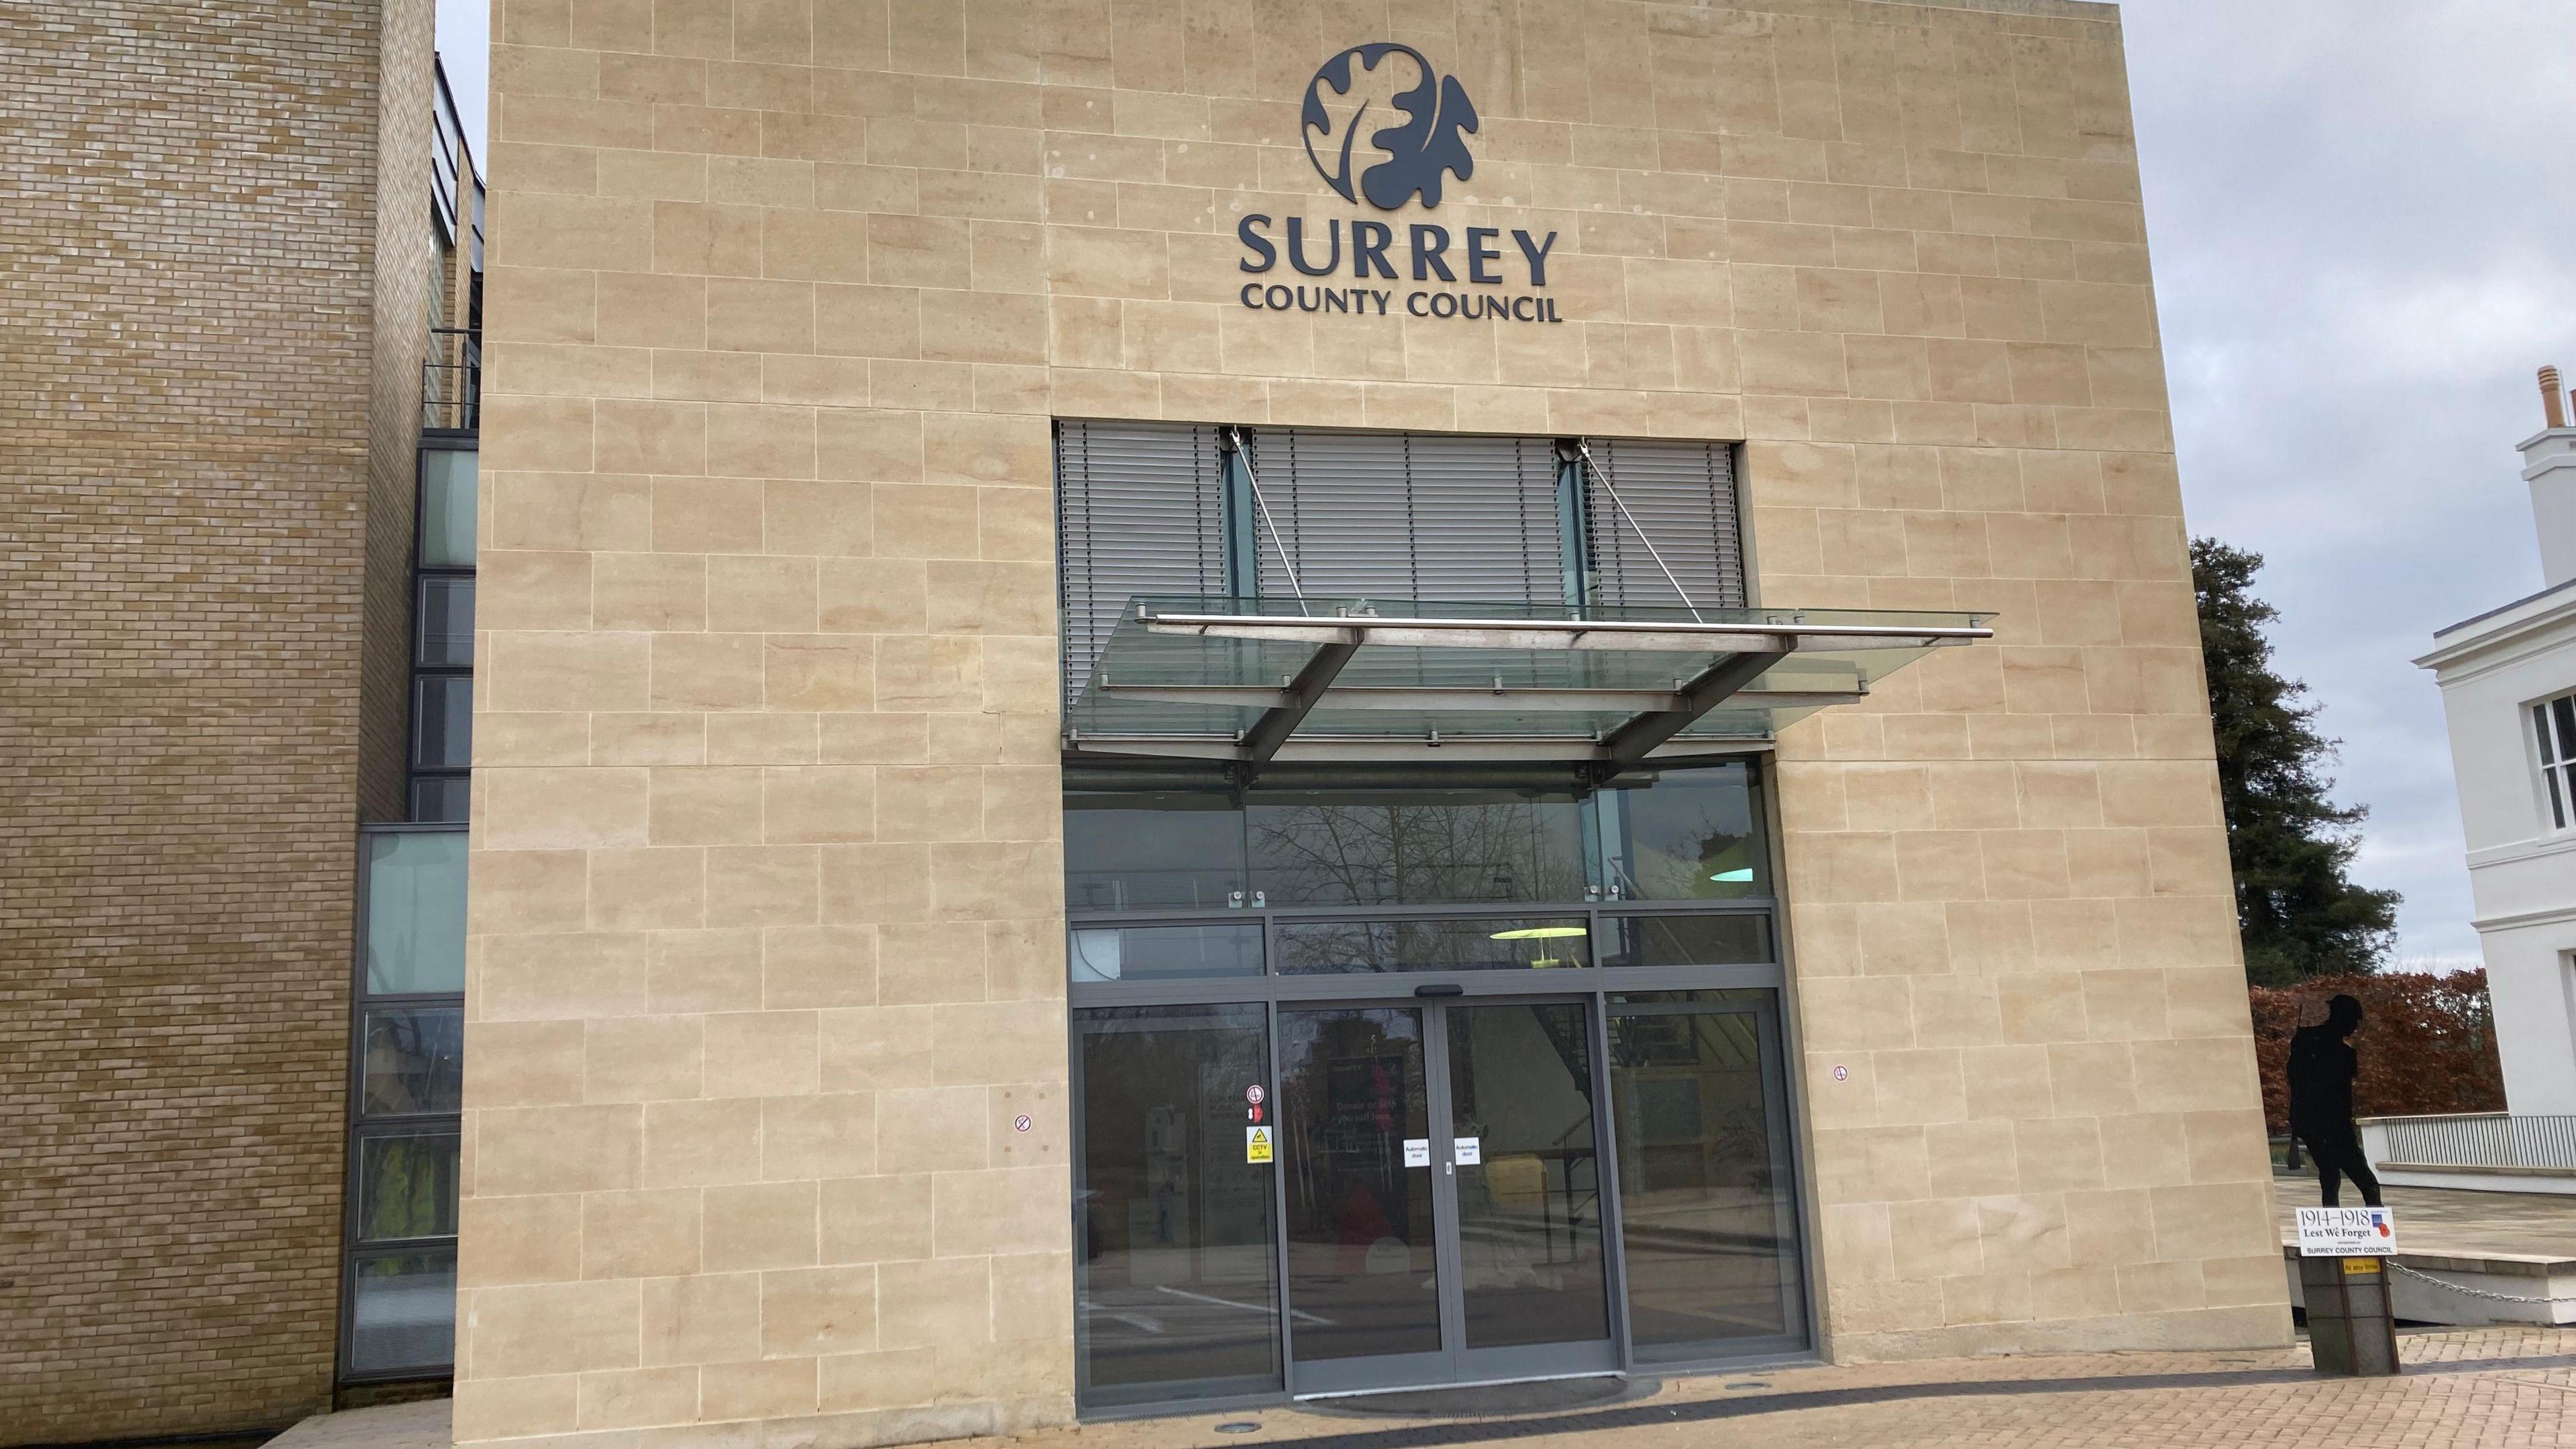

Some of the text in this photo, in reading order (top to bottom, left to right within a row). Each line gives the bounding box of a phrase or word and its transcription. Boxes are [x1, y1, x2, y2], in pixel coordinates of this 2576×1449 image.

[1238, 213, 1558, 286] SURREY
[1240, 283, 1563, 322] COUNTY COUNCIL
[2304, 1229, 2371, 1239] Lest We Forget
